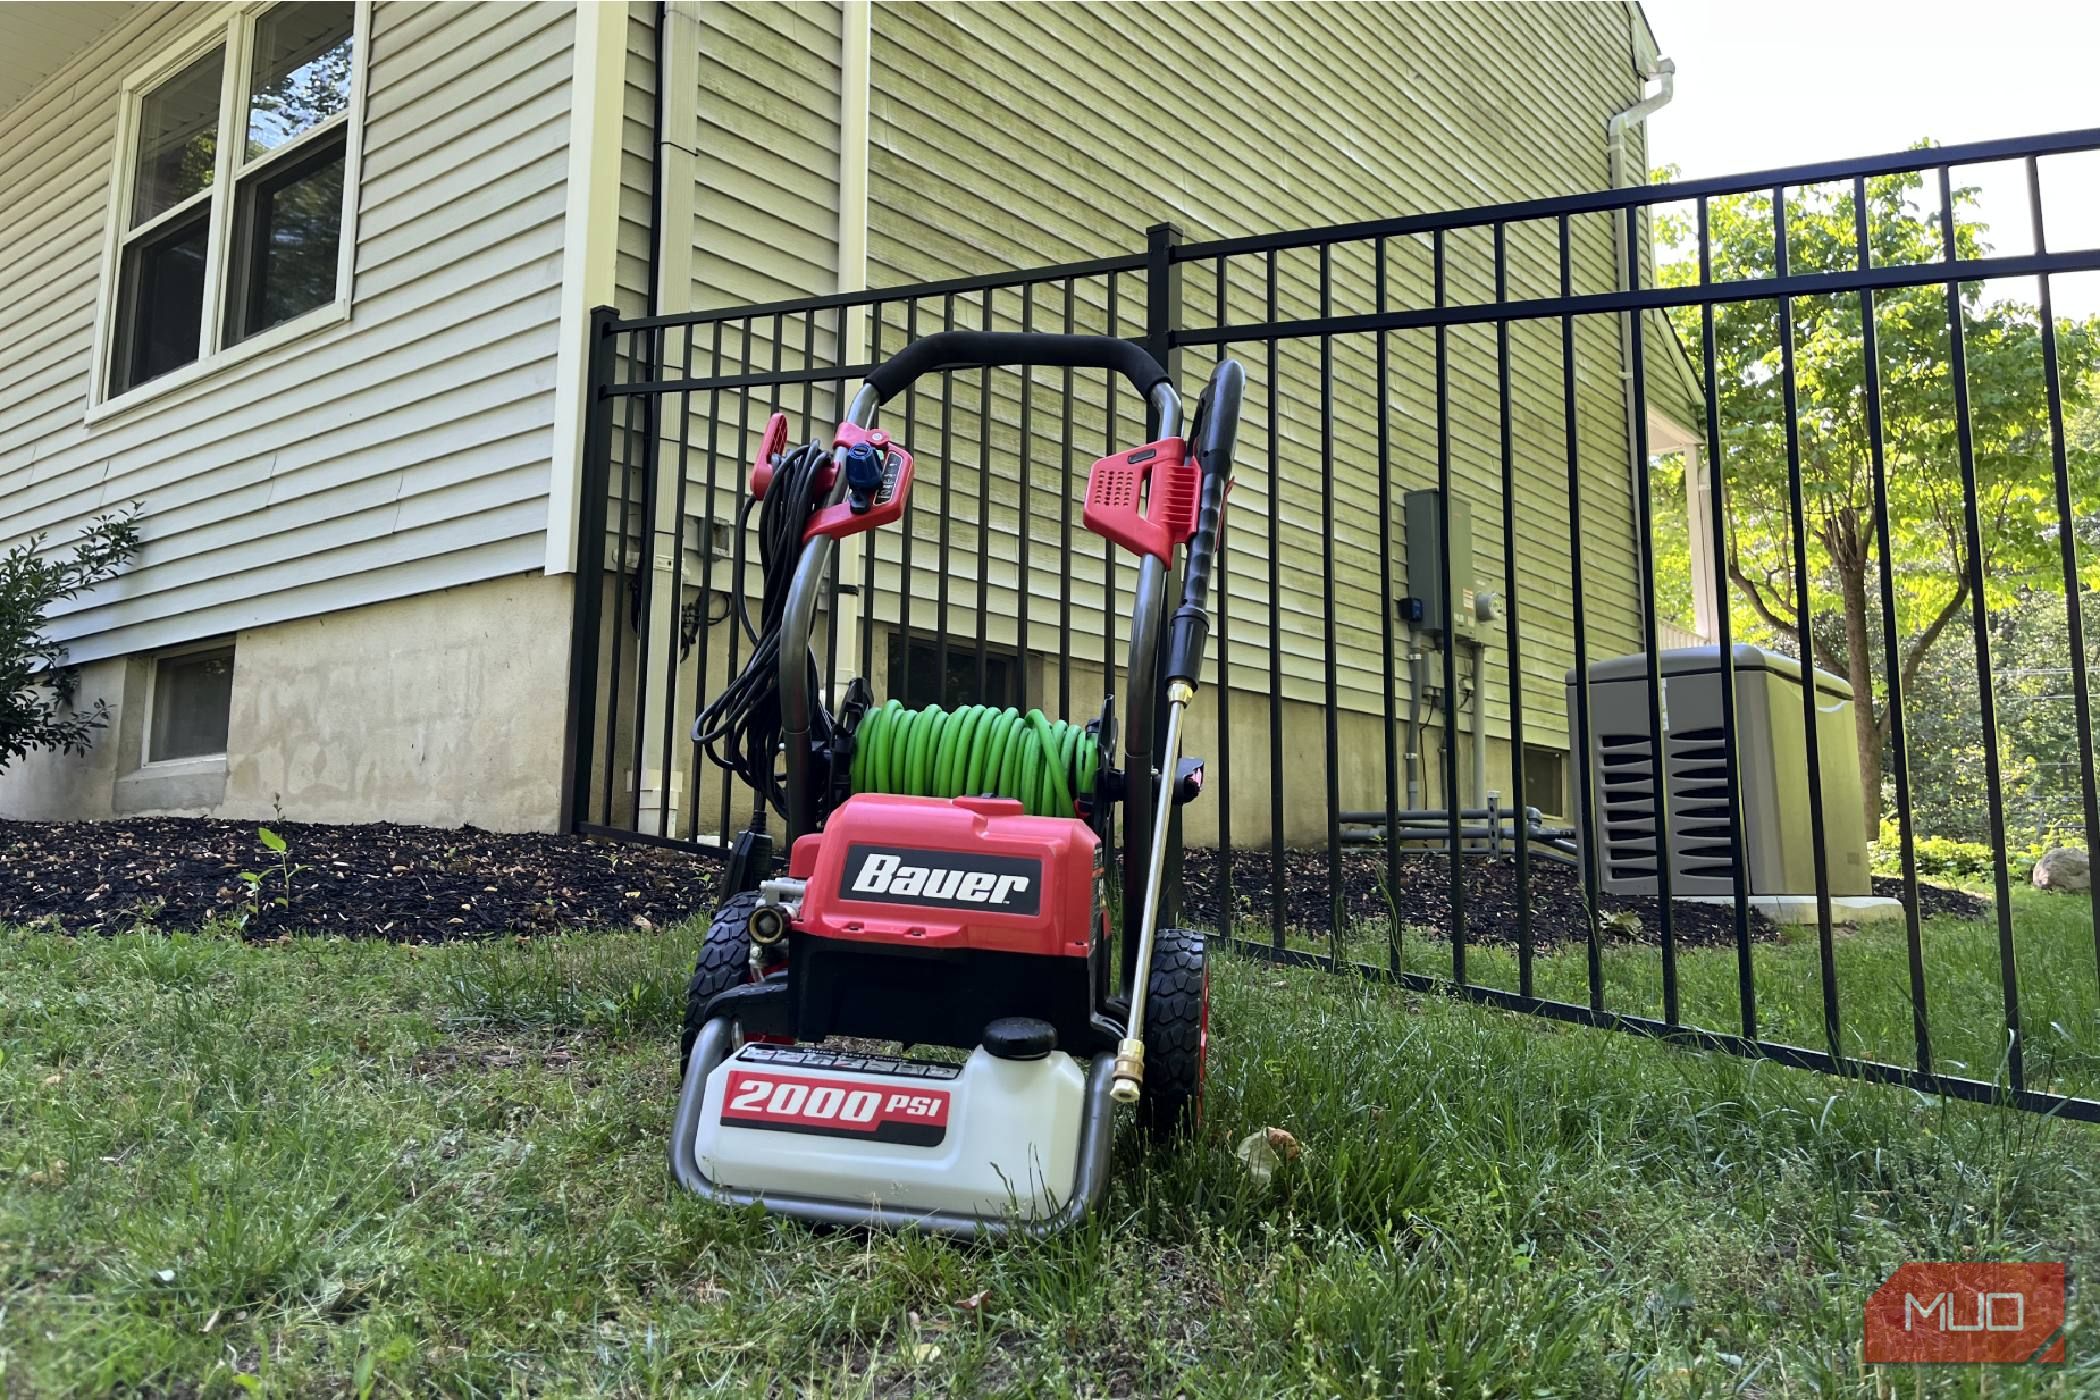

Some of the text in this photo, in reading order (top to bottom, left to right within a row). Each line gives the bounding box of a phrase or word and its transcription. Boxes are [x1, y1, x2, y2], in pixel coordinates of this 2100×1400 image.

[851, 853, 1029, 904] Bauer
[730, 1080, 942, 1122] 2000 PSI
